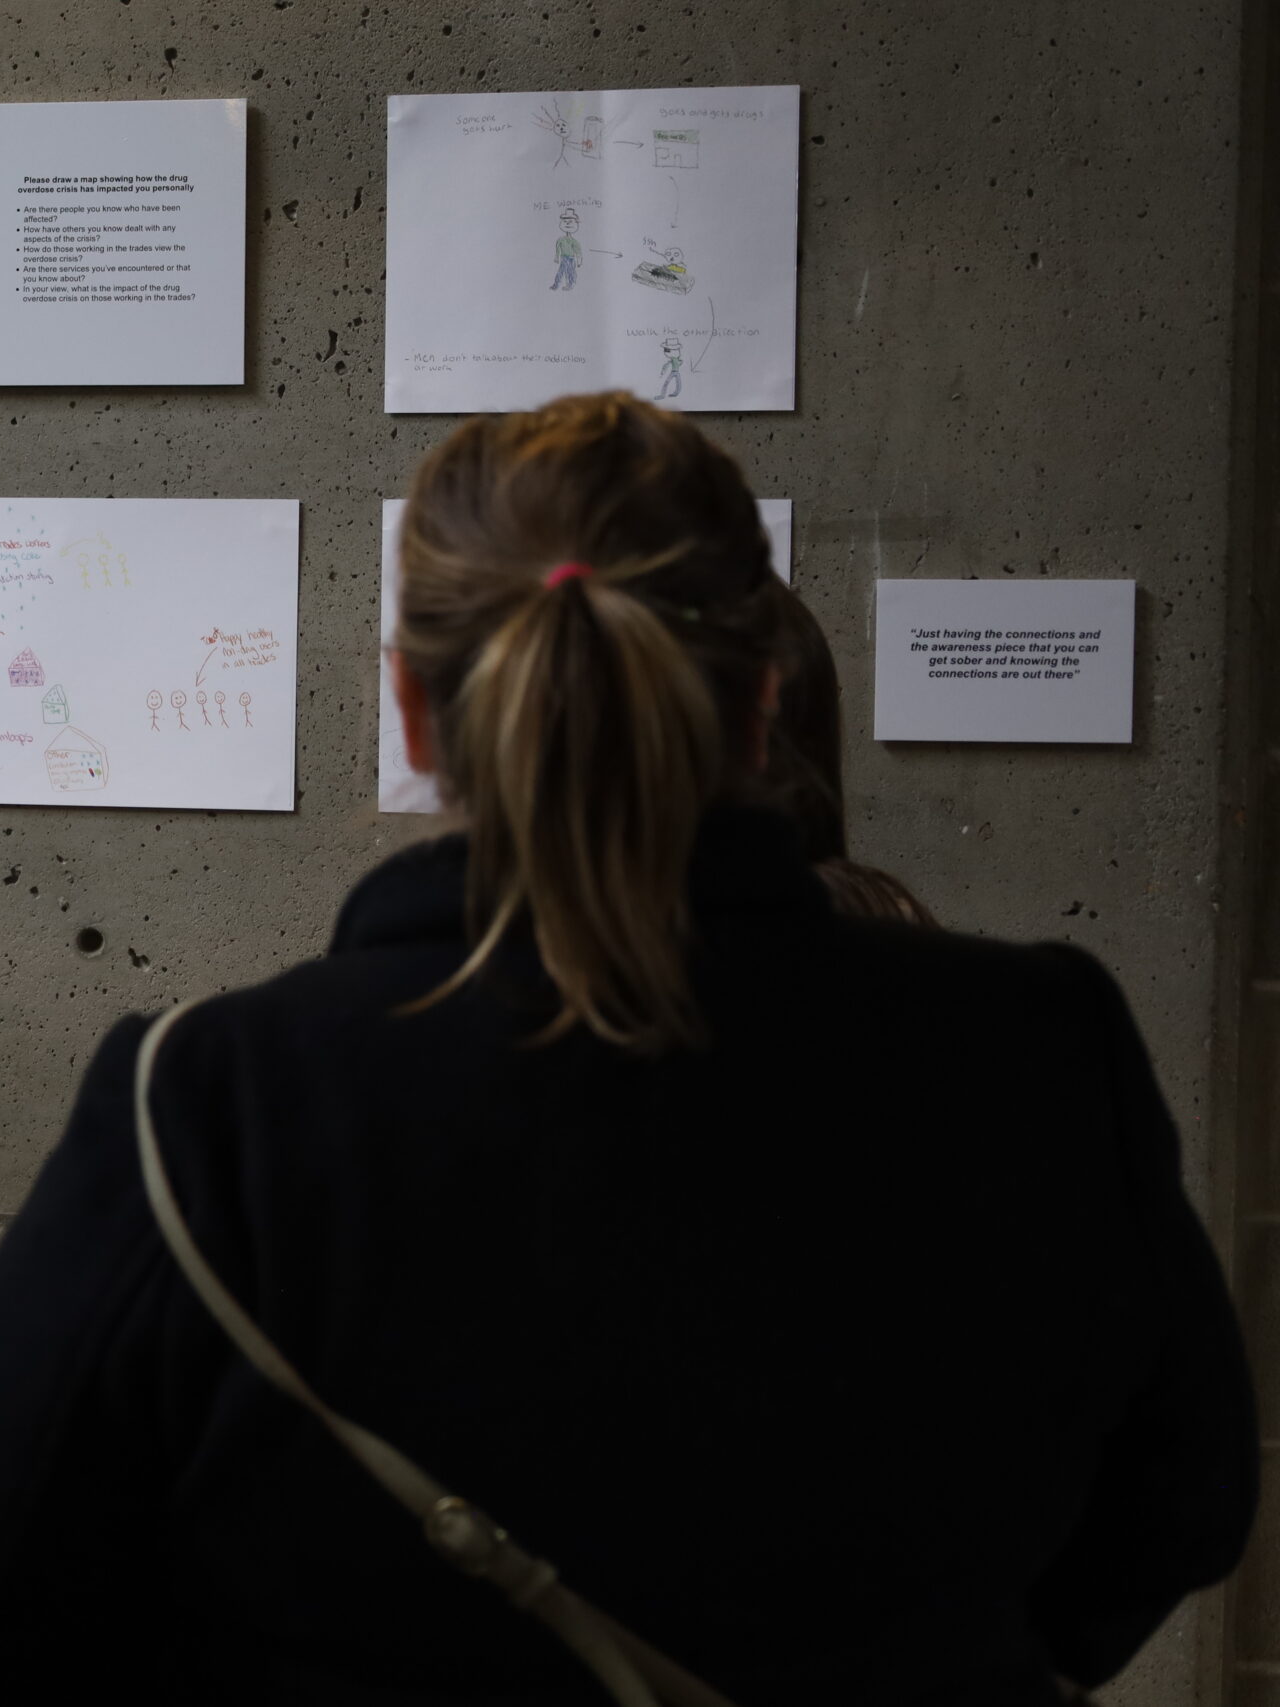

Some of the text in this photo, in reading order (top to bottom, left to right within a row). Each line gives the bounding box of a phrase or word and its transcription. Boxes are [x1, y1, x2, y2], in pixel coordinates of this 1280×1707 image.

[24, 176, 50, 184] Please
[80, 177, 98, 185] map
[100, 176, 133, 184] showing
[169, 175, 188, 183] drug
[96, 185, 133, 194] impacted
[152, 184, 194, 193] personally
[60, 205, 85, 214] people
[75, 245, 105, 254] working
[91, 265, 116, 273] you've
[113, 285, 138, 293] impact
[163, 284, 180, 292] drug
[113, 294, 143, 303] working
[167, 293, 196, 301] trades?
[943, 629, 981, 640] having
[985, 629, 1002, 639] the
[1005, 630, 1075, 639] connections
[1079, 630, 1101, 639] and
[910, 643, 1099, 654] the awareness piece that you can
[929, 656, 1080, 668] get sober and knowing the
[928, 669, 998, 678] connections
[1001, 670, 1019, 679] are
[1022, 669, 1042, 679] out
